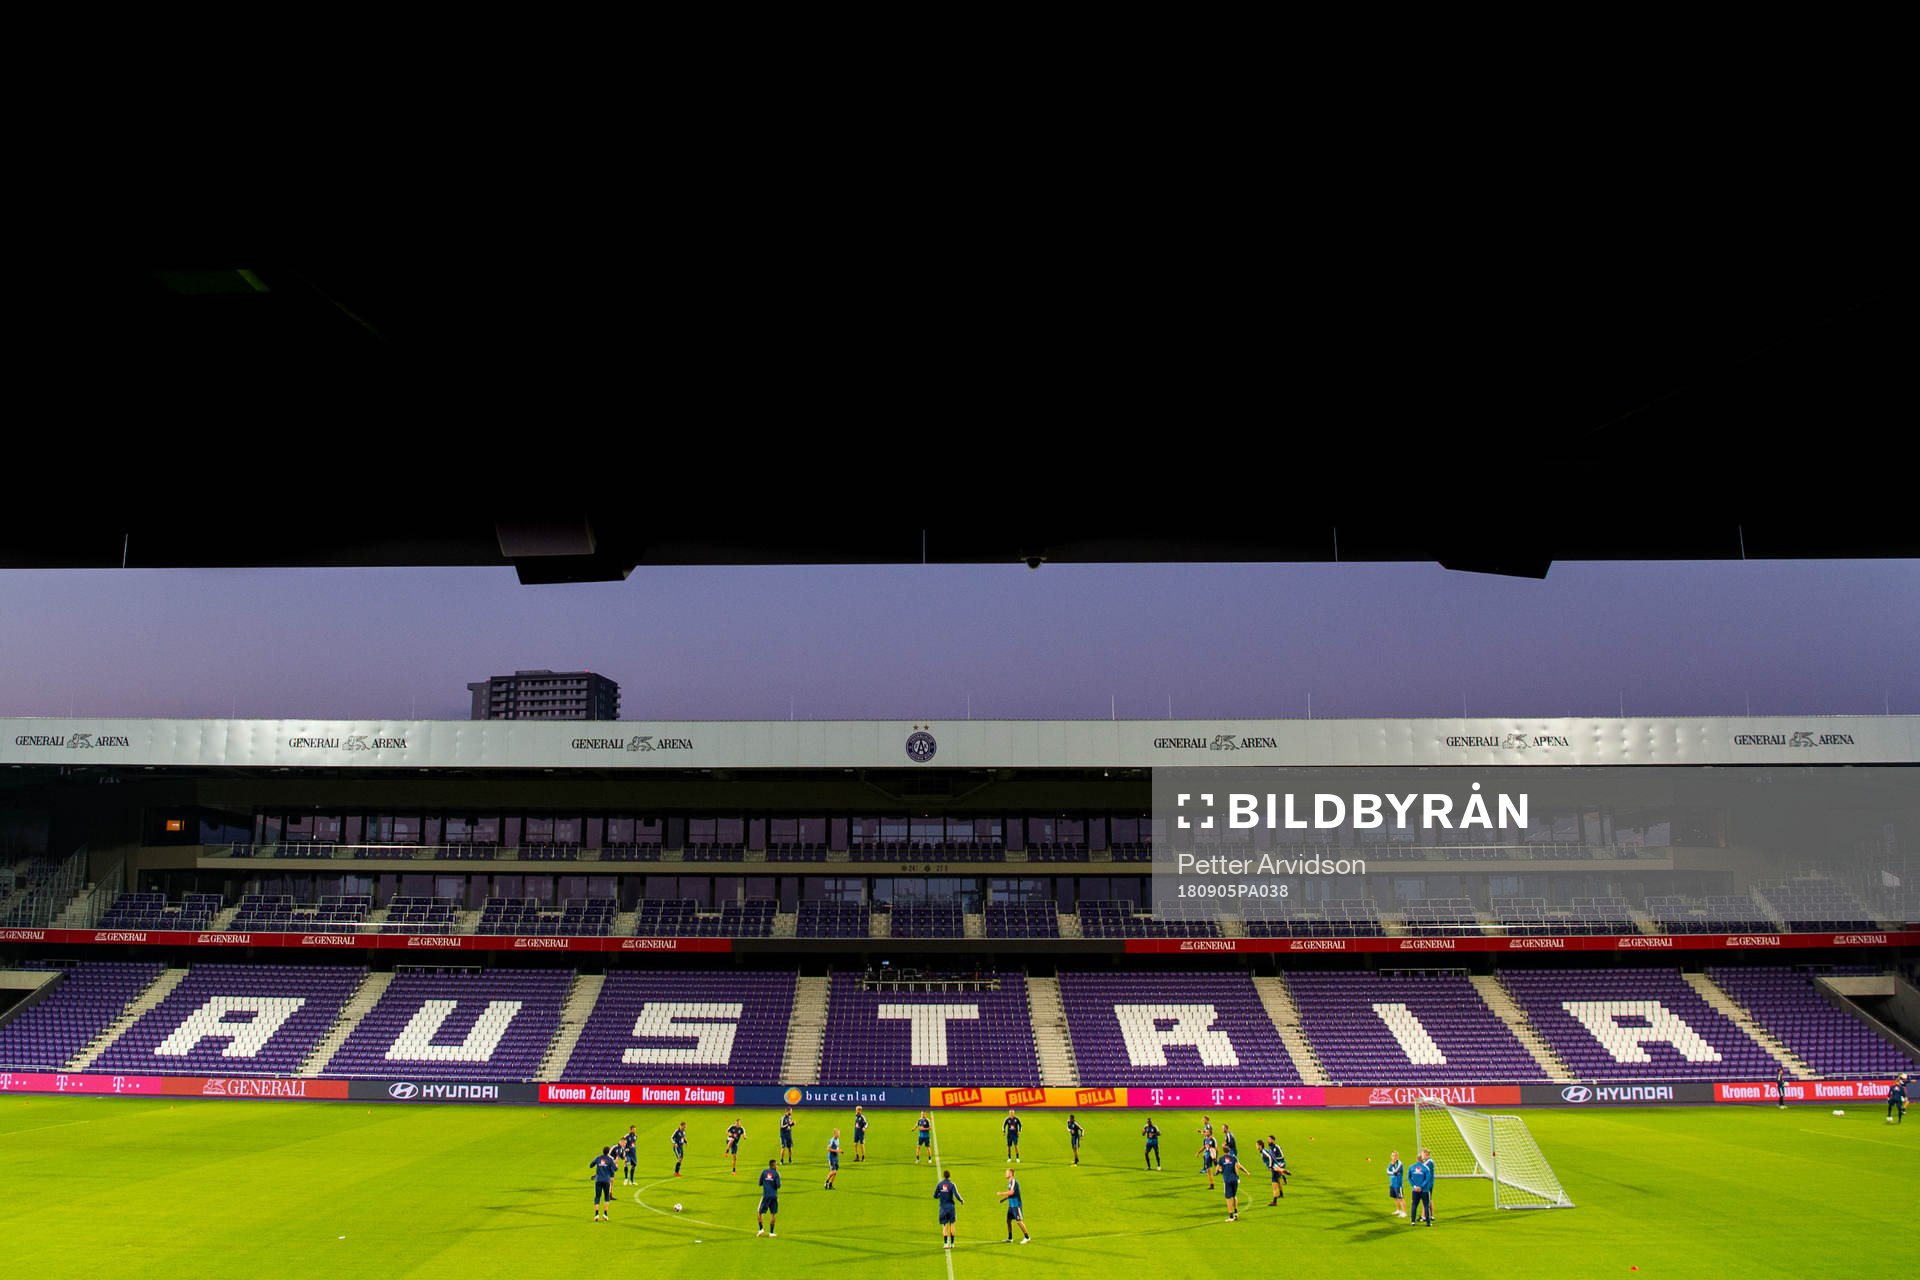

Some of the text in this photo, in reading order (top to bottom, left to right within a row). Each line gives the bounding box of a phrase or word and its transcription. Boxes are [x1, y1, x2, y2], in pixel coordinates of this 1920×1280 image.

[15, 736, 129, 747] GENERALI ARENA
[289, 737, 407, 748] GENERALI ARENA
[572, 738, 693, 749] GENERALI ARENA
[1153, 738, 1277, 749] GENERALI ARENA
[1446, 736, 1498, 747] GENERALI
[1734, 734, 1854, 745] GENERALI ARENA
[5, 931, 45, 940] GENERALI
[107, 933, 147, 942] GENERALI
[211, 934, 250, 943] GENERALI
[315, 936, 355, 945] GENERALI
[1739, 936, 1780, 945] GENERALI
[1846, 935, 1886, 944] GENERALI
[420, 937, 461, 947] GENERALI
[527, 938, 568, 948] GENERALI
[635, 940, 676, 949] GENERALI
[1193, 941, 1235, 950] GENERALI
[1303, 940, 1345, 949] GENERALI
[1413, 940, 1455, 949] GENERALI
[1522, 939, 1564, 948] GENERALI
[1631, 938, 1672, 947] GENERALI
[228, 1079, 305, 1097] GENERALI
[422, 1084, 498, 1099] HYUNDAI
[1596, 1086, 1673, 1101] HYUNDAI
[1722, 1084, 1760, 1098] Kronen
[1815, 1082, 1891, 1097] Kronen Zeitun
[548, 1086, 630, 1103] Kronen Zeitung
[642, 1087, 725, 1103] Kronen Zeitung
[806, 1090, 886, 1104] burgenland
[944, 1090, 981, 1105] BILLA
[1008, 1090, 1044, 1105] BILLA
[1078, 1090, 1115, 1105] BILLA
